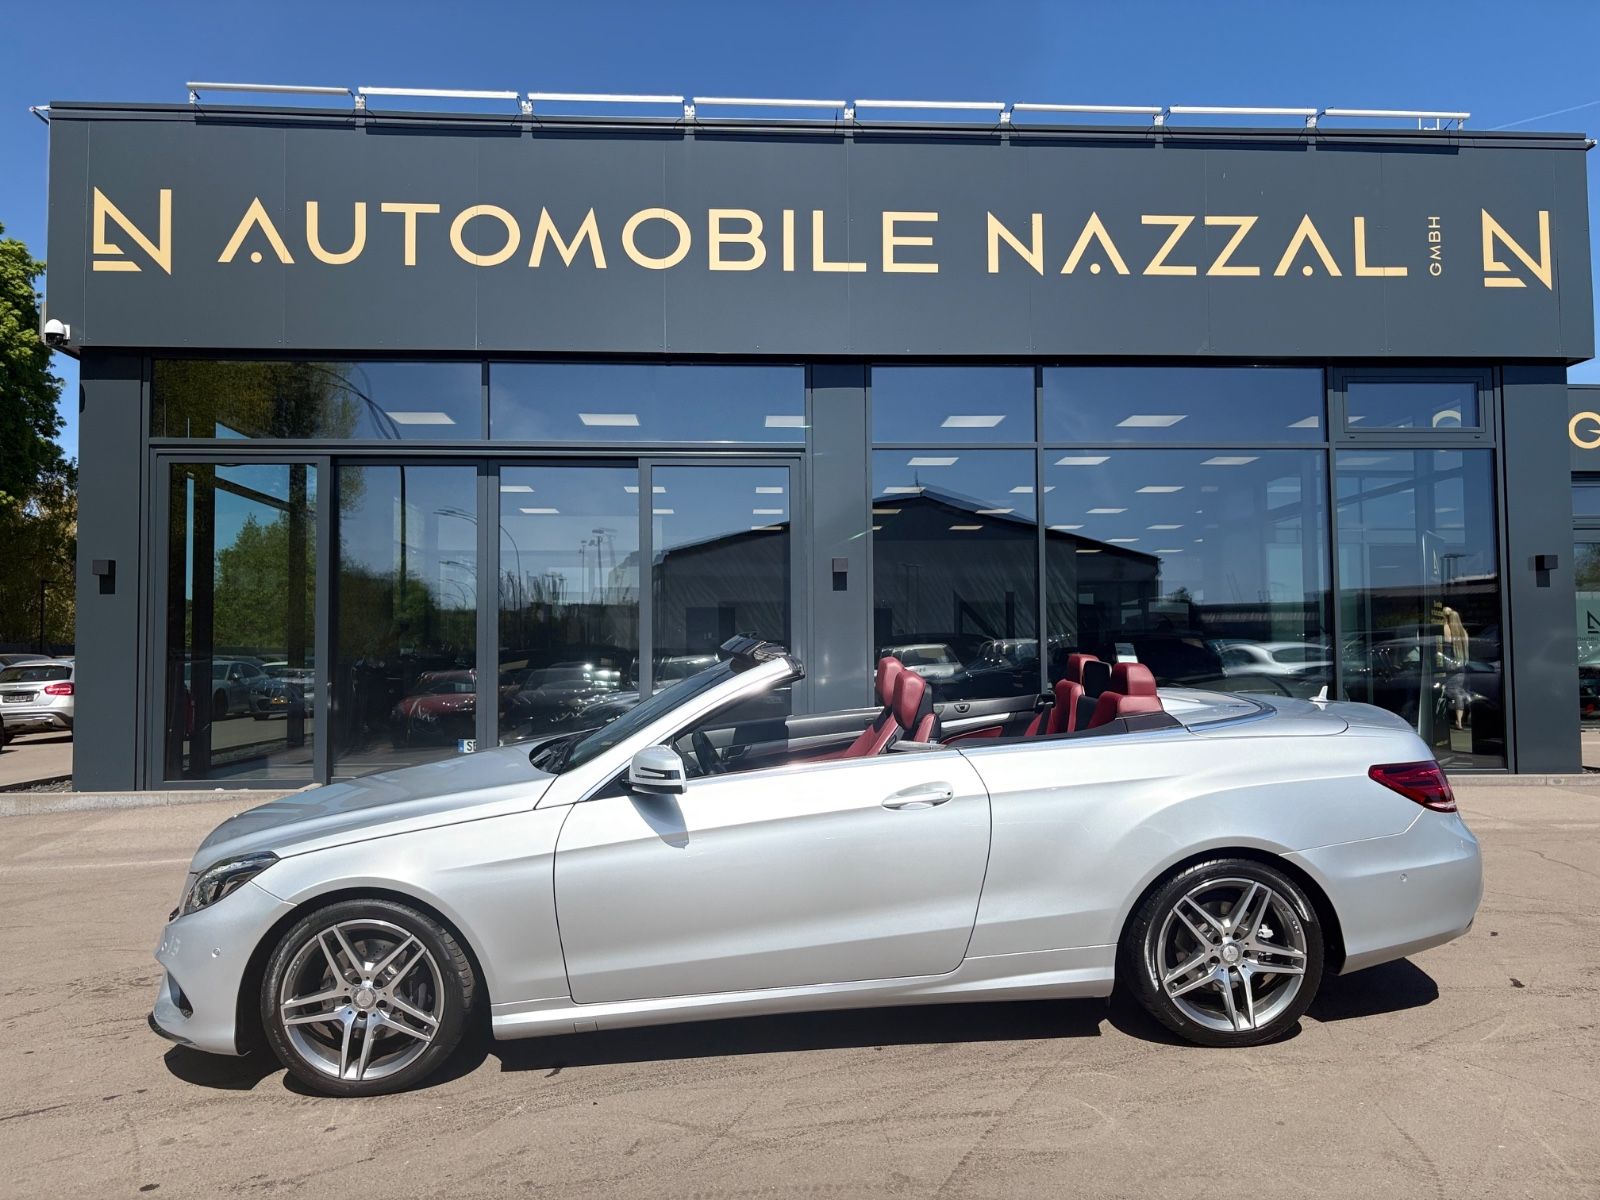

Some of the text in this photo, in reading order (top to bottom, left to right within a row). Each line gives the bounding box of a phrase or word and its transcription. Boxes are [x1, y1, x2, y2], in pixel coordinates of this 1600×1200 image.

[218, 196, 1409, 277] AUTOMOBILE NAZZAL
[1427, 216, 1442, 277] GMBH
